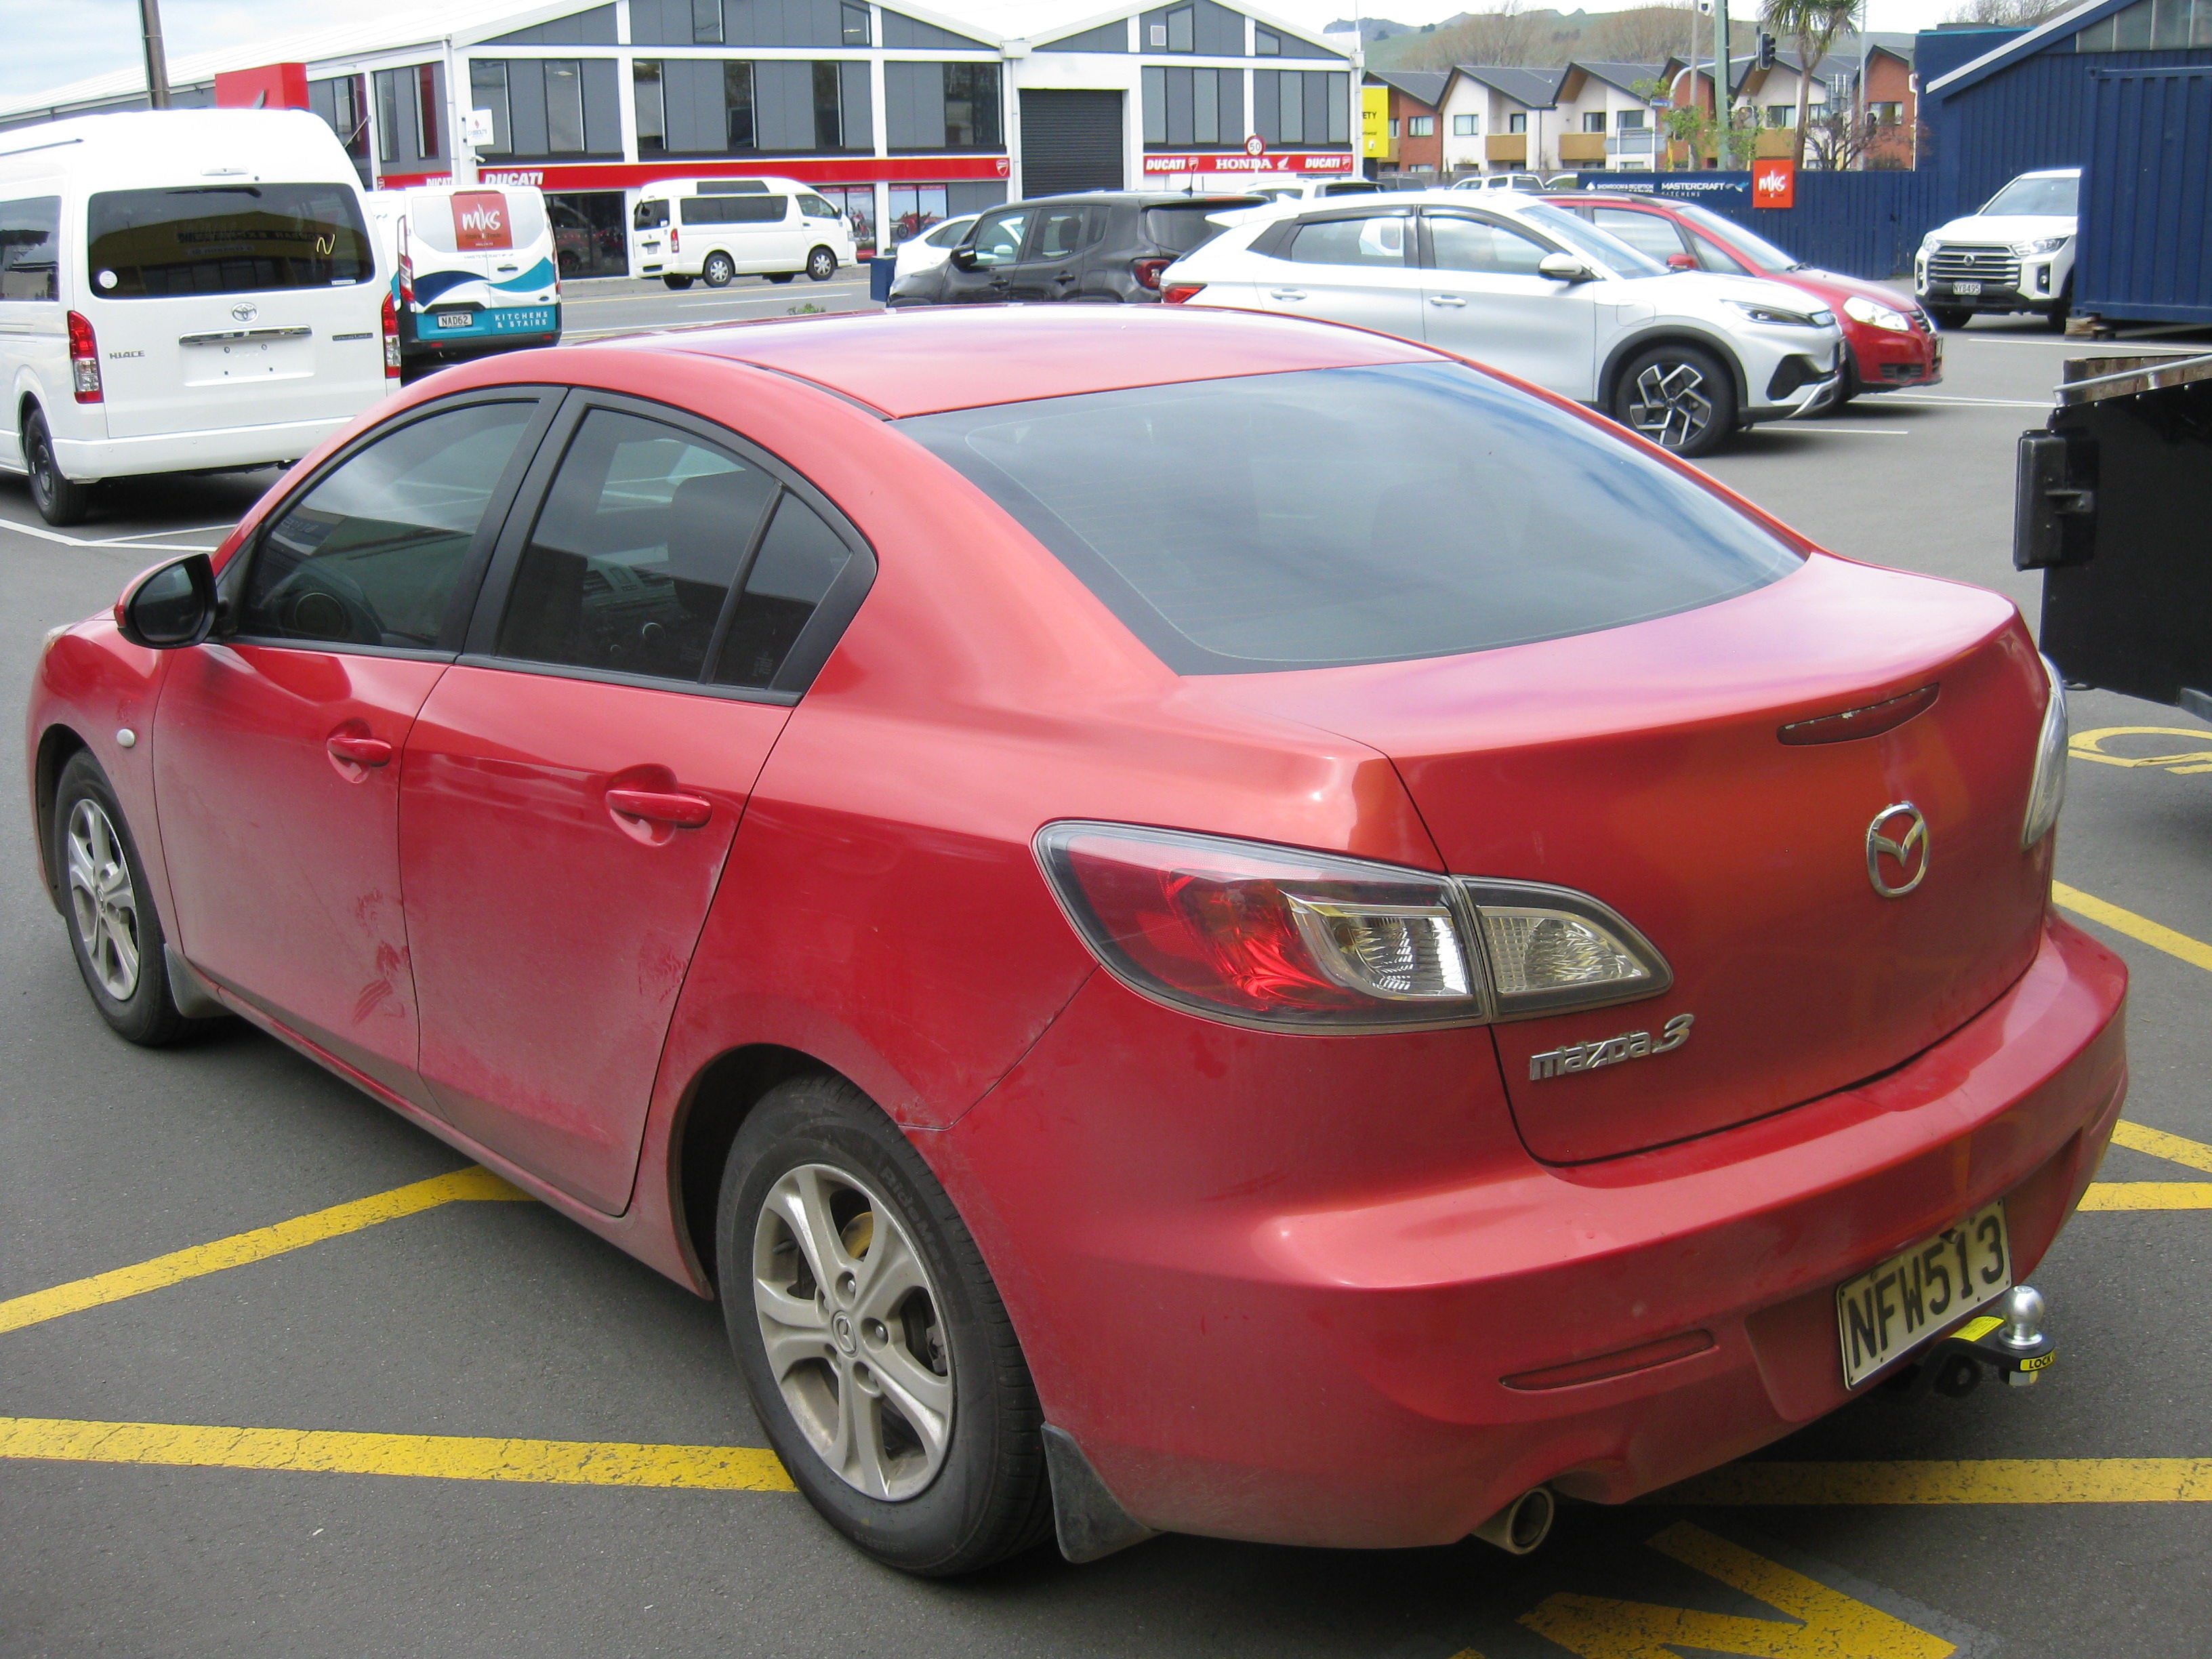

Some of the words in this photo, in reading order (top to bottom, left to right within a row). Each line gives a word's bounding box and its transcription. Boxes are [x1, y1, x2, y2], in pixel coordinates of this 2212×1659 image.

[1250, 142, 1261, 151] 50
[1146, 159, 1186, 169] DUCATI
[1216, 159, 1272, 169] HONDA
[1305, 157, 1340, 169] DUCATI
[485, 172, 544, 185] DUCATI
[1661, 182, 1725, 190] MASTERCRAFT
[462, 203, 501, 232] mks
[441, 315, 469, 326] NAD62
[495, 311, 548, 321] KITCHENS
[510, 319, 547, 328] STAIRS
[109, 349, 145, 359] HIACE
[1847, 1215, 2005, 1369] NFW513
